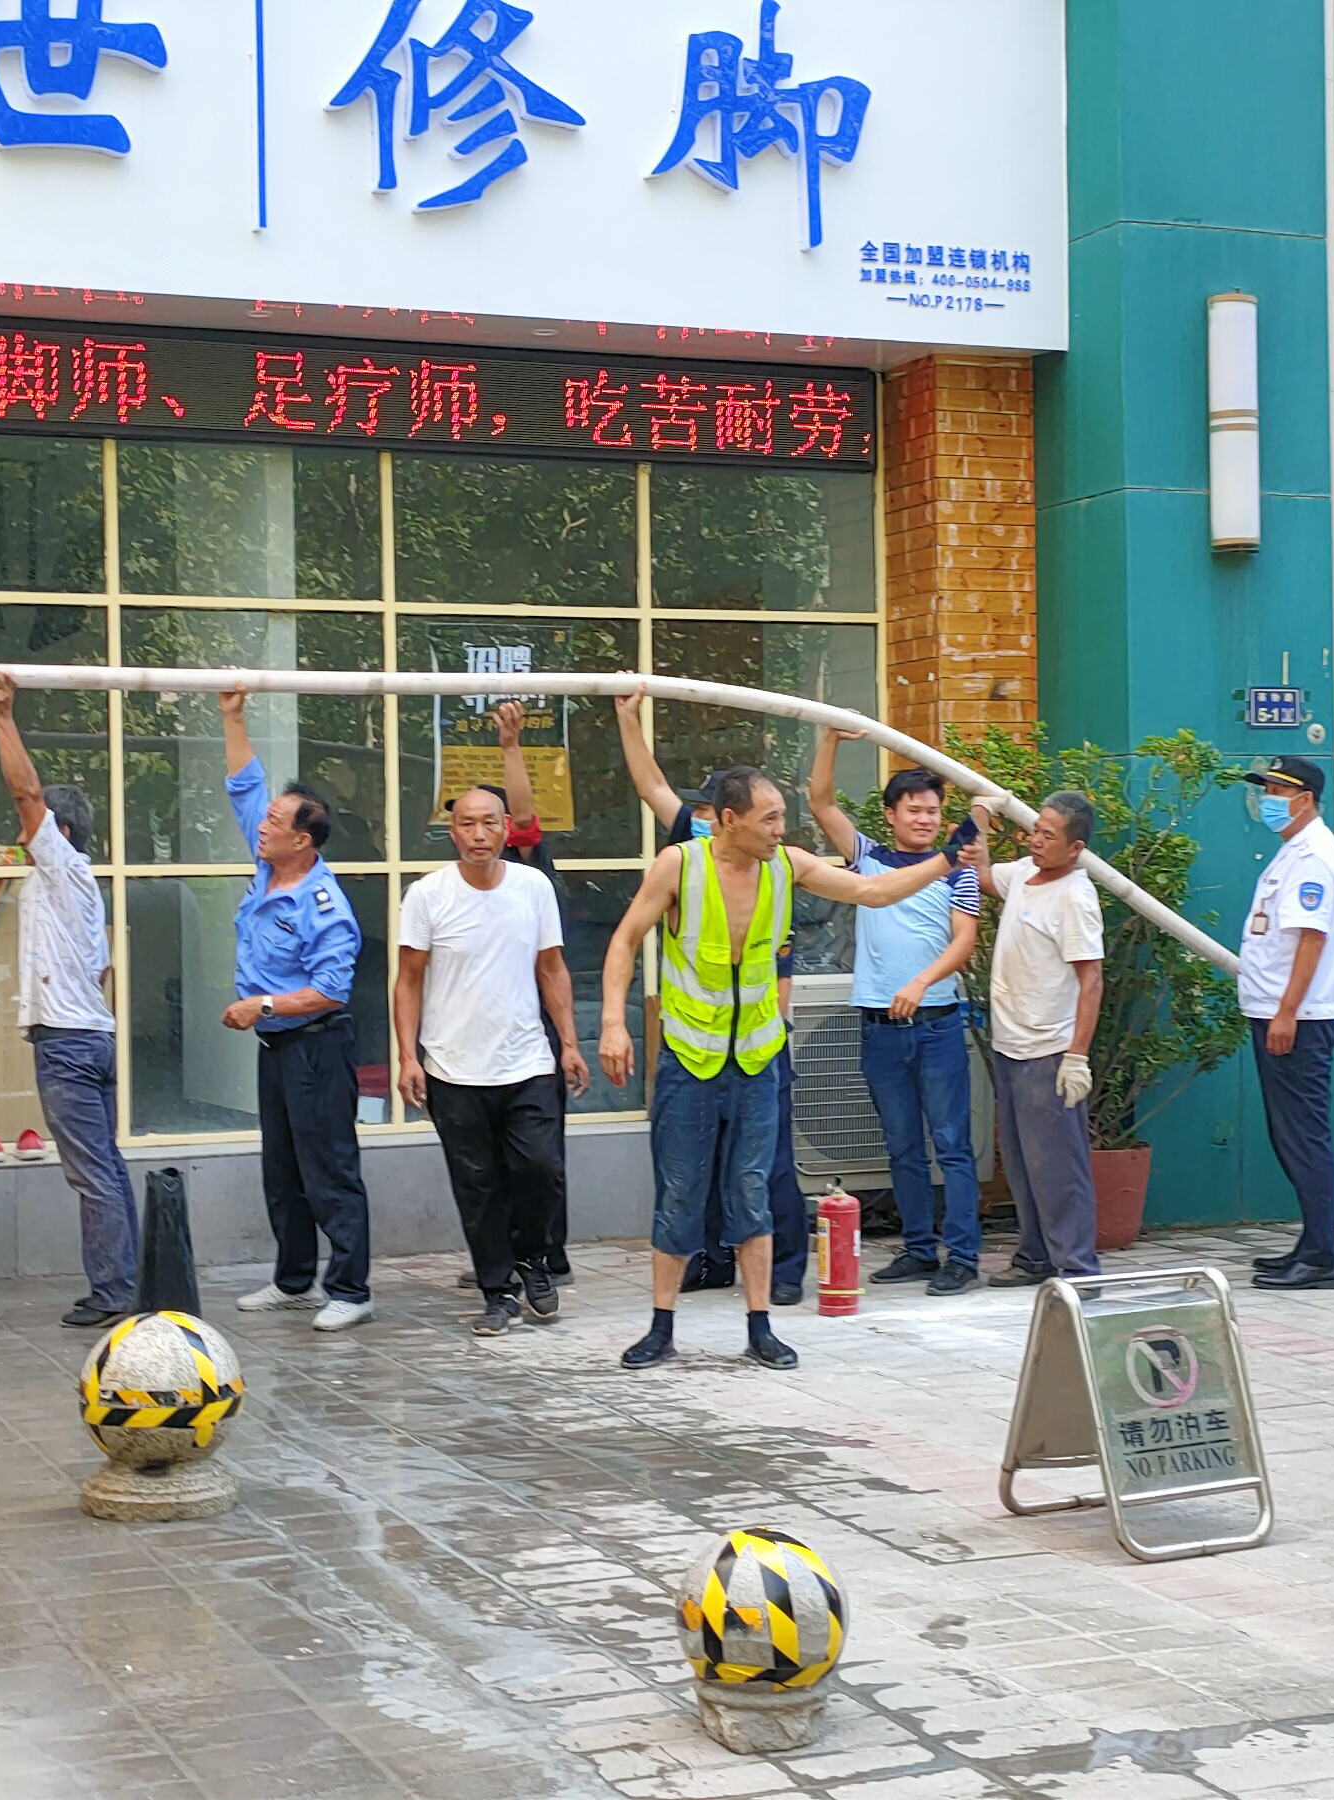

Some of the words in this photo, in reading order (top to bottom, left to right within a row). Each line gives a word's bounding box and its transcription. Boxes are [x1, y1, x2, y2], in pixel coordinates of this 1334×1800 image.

[860, 240, 1031, 274] 全国加盟连锁机构
[1119, 1409, 1230, 1448] 请勿泊车
[1125, 1456, 1153, 1479] NO
[1157, 1446, 1236, 1476] PARKING
